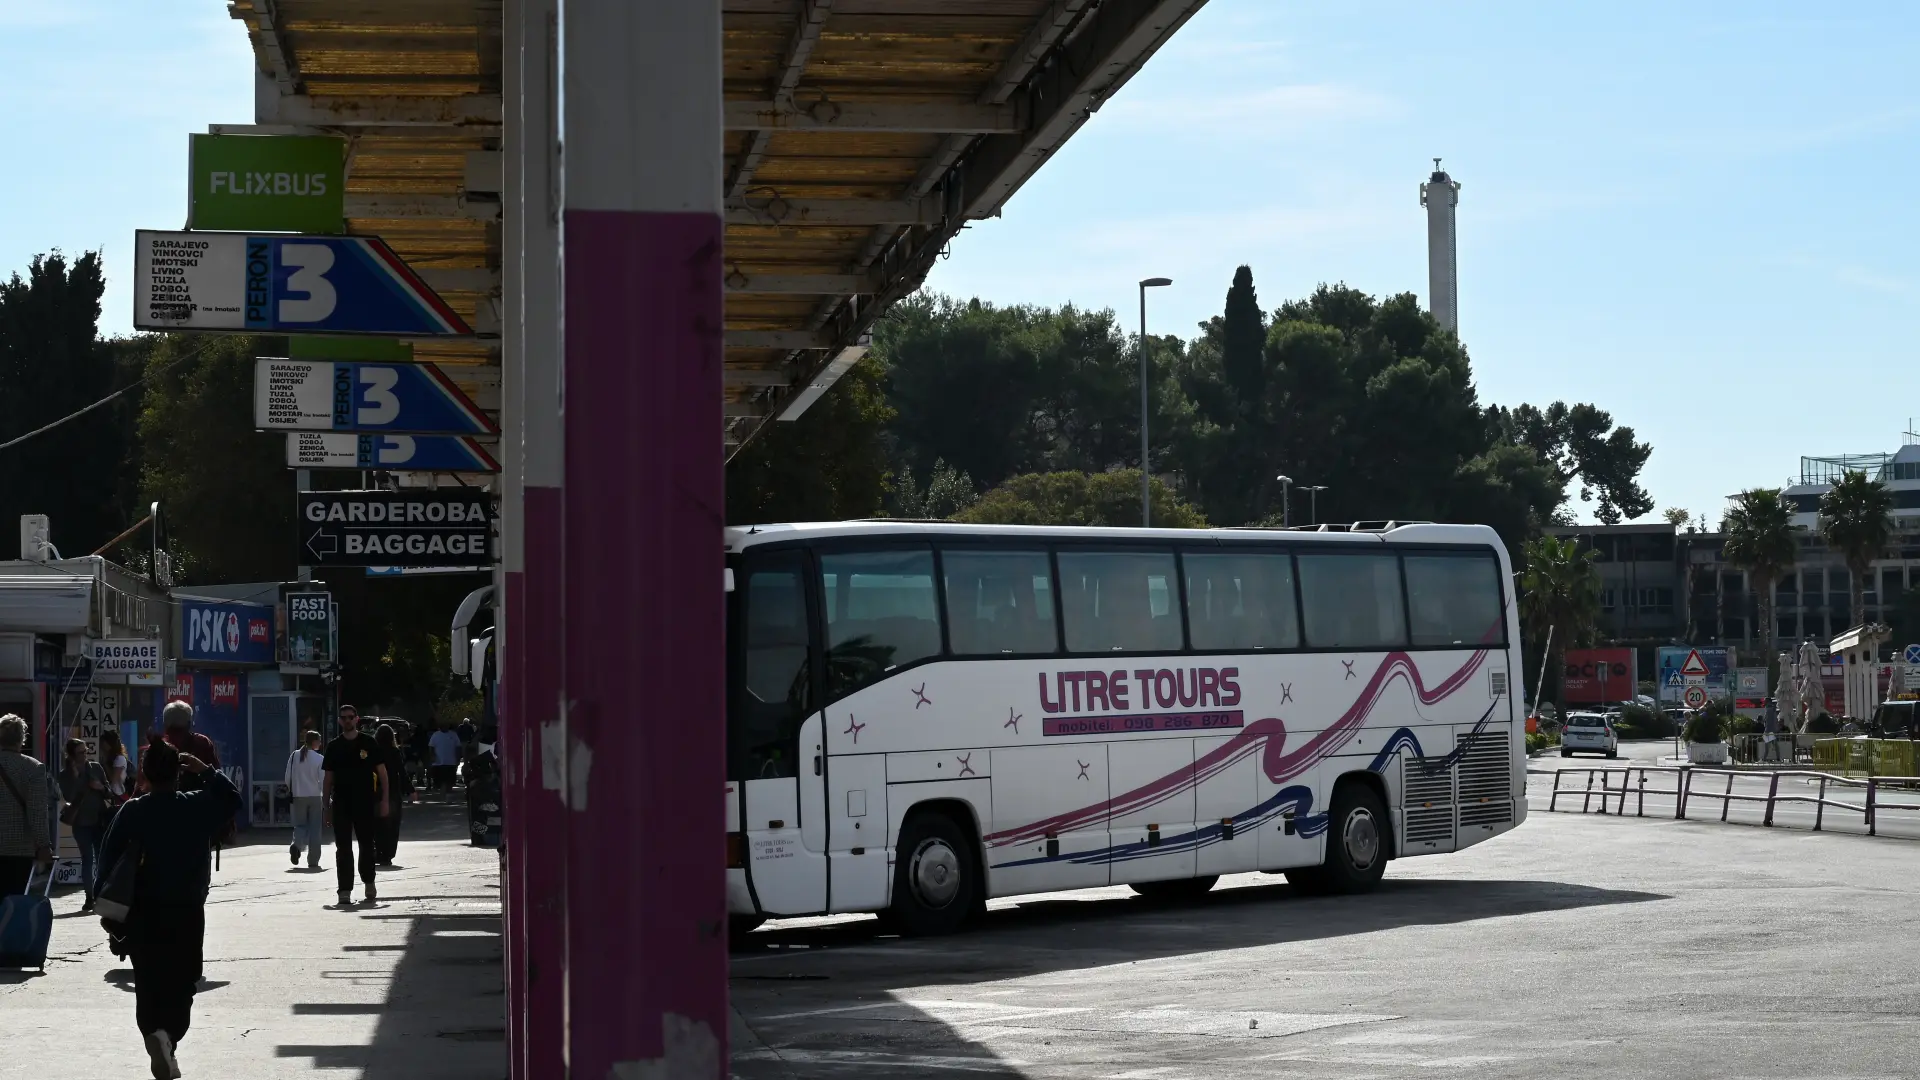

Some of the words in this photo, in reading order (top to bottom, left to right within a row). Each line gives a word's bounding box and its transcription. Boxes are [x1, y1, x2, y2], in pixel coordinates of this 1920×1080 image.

[152, 240, 209, 249] SARAJEVO
[152, 249, 203, 258] VINKOVCI
[151, 258, 198, 267] IMOTSKI
[151, 267, 184, 275] LIVNO
[152, 276, 186, 284] TUZLA
[247, 243, 268, 322] PERON
[278, 243, 337, 323] 3
[151, 285, 189, 293] DOBOJ
[151, 294, 192, 302] ZENICA
[335, 368, 350, 425] PERON
[357, 367, 400, 425] 3
[306, 502, 486, 522] GARDEROBA
[346, 535, 485, 554] BAGGAGE
[292, 598, 326, 610] FAST
[292, 611, 326, 620] FOOD
[188, 608, 226, 653] PSK
[250, 624, 266, 638] psk.hr
[95, 646, 157, 657] BAGGAGE
[107, 660, 157, 669] LUGGAGE
[214, 681, 235, 700] psk.hr
[1039, 670, 1130, 713] LITRE
[1134, 667, 1241, 710] TOURS
[1690, 692, 1700, 701] 20
[83, 691, 99, 761] GAME
[1124, 718, 1154, 729] 098
[1164, 716, 1192, 728] 286
[1202, 714, 1230, 726] 870
